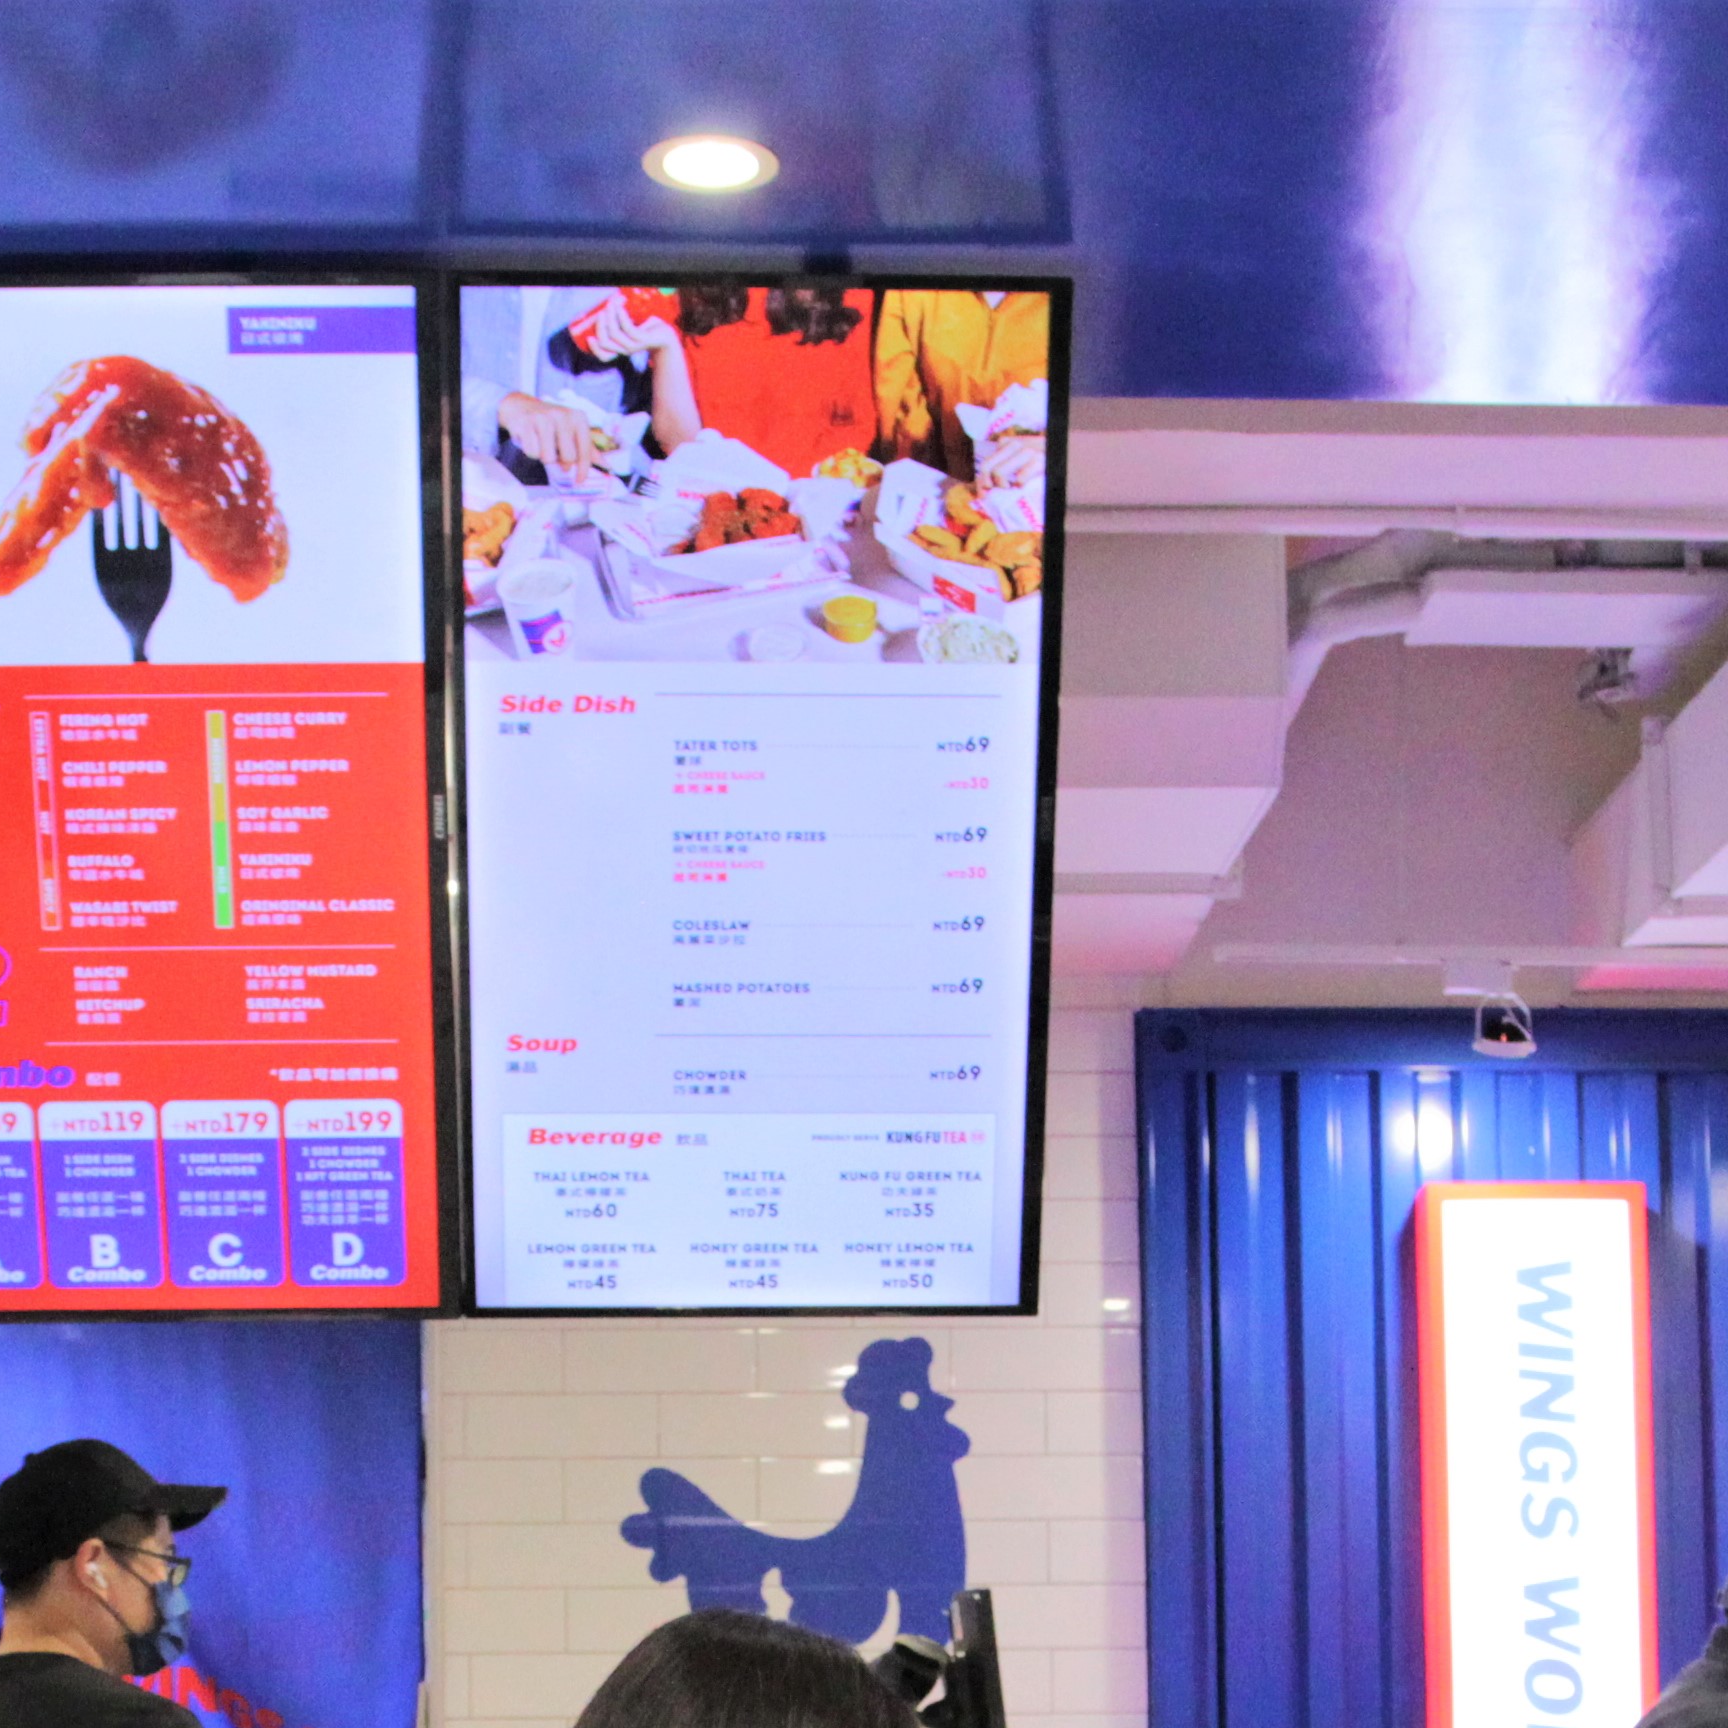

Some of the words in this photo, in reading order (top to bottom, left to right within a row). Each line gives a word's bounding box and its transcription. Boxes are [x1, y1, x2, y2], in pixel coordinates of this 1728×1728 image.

[500, 695, 563, 714] Side
[573, 695, 637, 714] Dish
[674, 740, 717, 751] TATER
[722, 740, 758, 751] TOTS
[937, 737, 990, 751] NTD69
[673, 831, 719, 841] SWEET
[725, 831, 780, 841] POTATO
[786, 831, 826, 841] FRIES
[935, 827, 988, 842] NTD69
[672, 919, 751, 932] COLESLAW
[933, 916, 985, 931] NTD69
[673, 982, 733, 994] MASHED
[737, 982, 811, 994] POTATOES
[931, 978, 983, 993] NTD69
[506, 1034, 578, 1055] Soup
[674, 1070, 747, 1080] CHOWDER
[930, 1065, 981, 1080] NTD69
[528, 1127, 663, 1149] Beverage
[534, 1172, 567, 1182] THAI
[572, 1172, 620, 1182] LEMON
[625, 1172, 650, 1182] TEA
[724, 1172, 756, 1182] THAI
[762, 1172, 786, 1182] TEA
[840, 1172, 879, 1182] KUNG
[885, 1172, 901, 1182] FU
[906, 1172, 952, 1182] GREEN
[958, 1172, 982, 1182] TEA
[565, 1203, 618, 1217] NTD60
[730, 1203, 779, 1217] NTD75
[885, 1203, 935, 1217] NTD35
[90, 1234, 120, 1268] B
[208, 1233, 243, 1267] C
[332, 1232, 365, 1266] D
[528, 1243, 576, 1253] LEMON
[582, 1243, 627, 1253] GREEN
[633, 1243, 656, 1253] TEA
[691, 1243, 738, 1253] HONEY
[743, 1243, 788, 1253] GREEN
[794, 1243, 819, 1253] TEA
[845, 1243, 892, 1253] HONEY
[898, 1243, 945, 1253] LEMON
[950, 1243, 974, 1253] TEA
[67, 1266, 147, 1283] Combo
[189, 1265, 268, 1281] Combo
[310, 1264, 389, 1280] Combo
[567, 1275, 618, 1289] NTD45
[729, 1275, 778, 1289] NTD45
[882, 1274, 934, 1288] NTD50
[1516, 1261, 1581, 1539] WINGS
